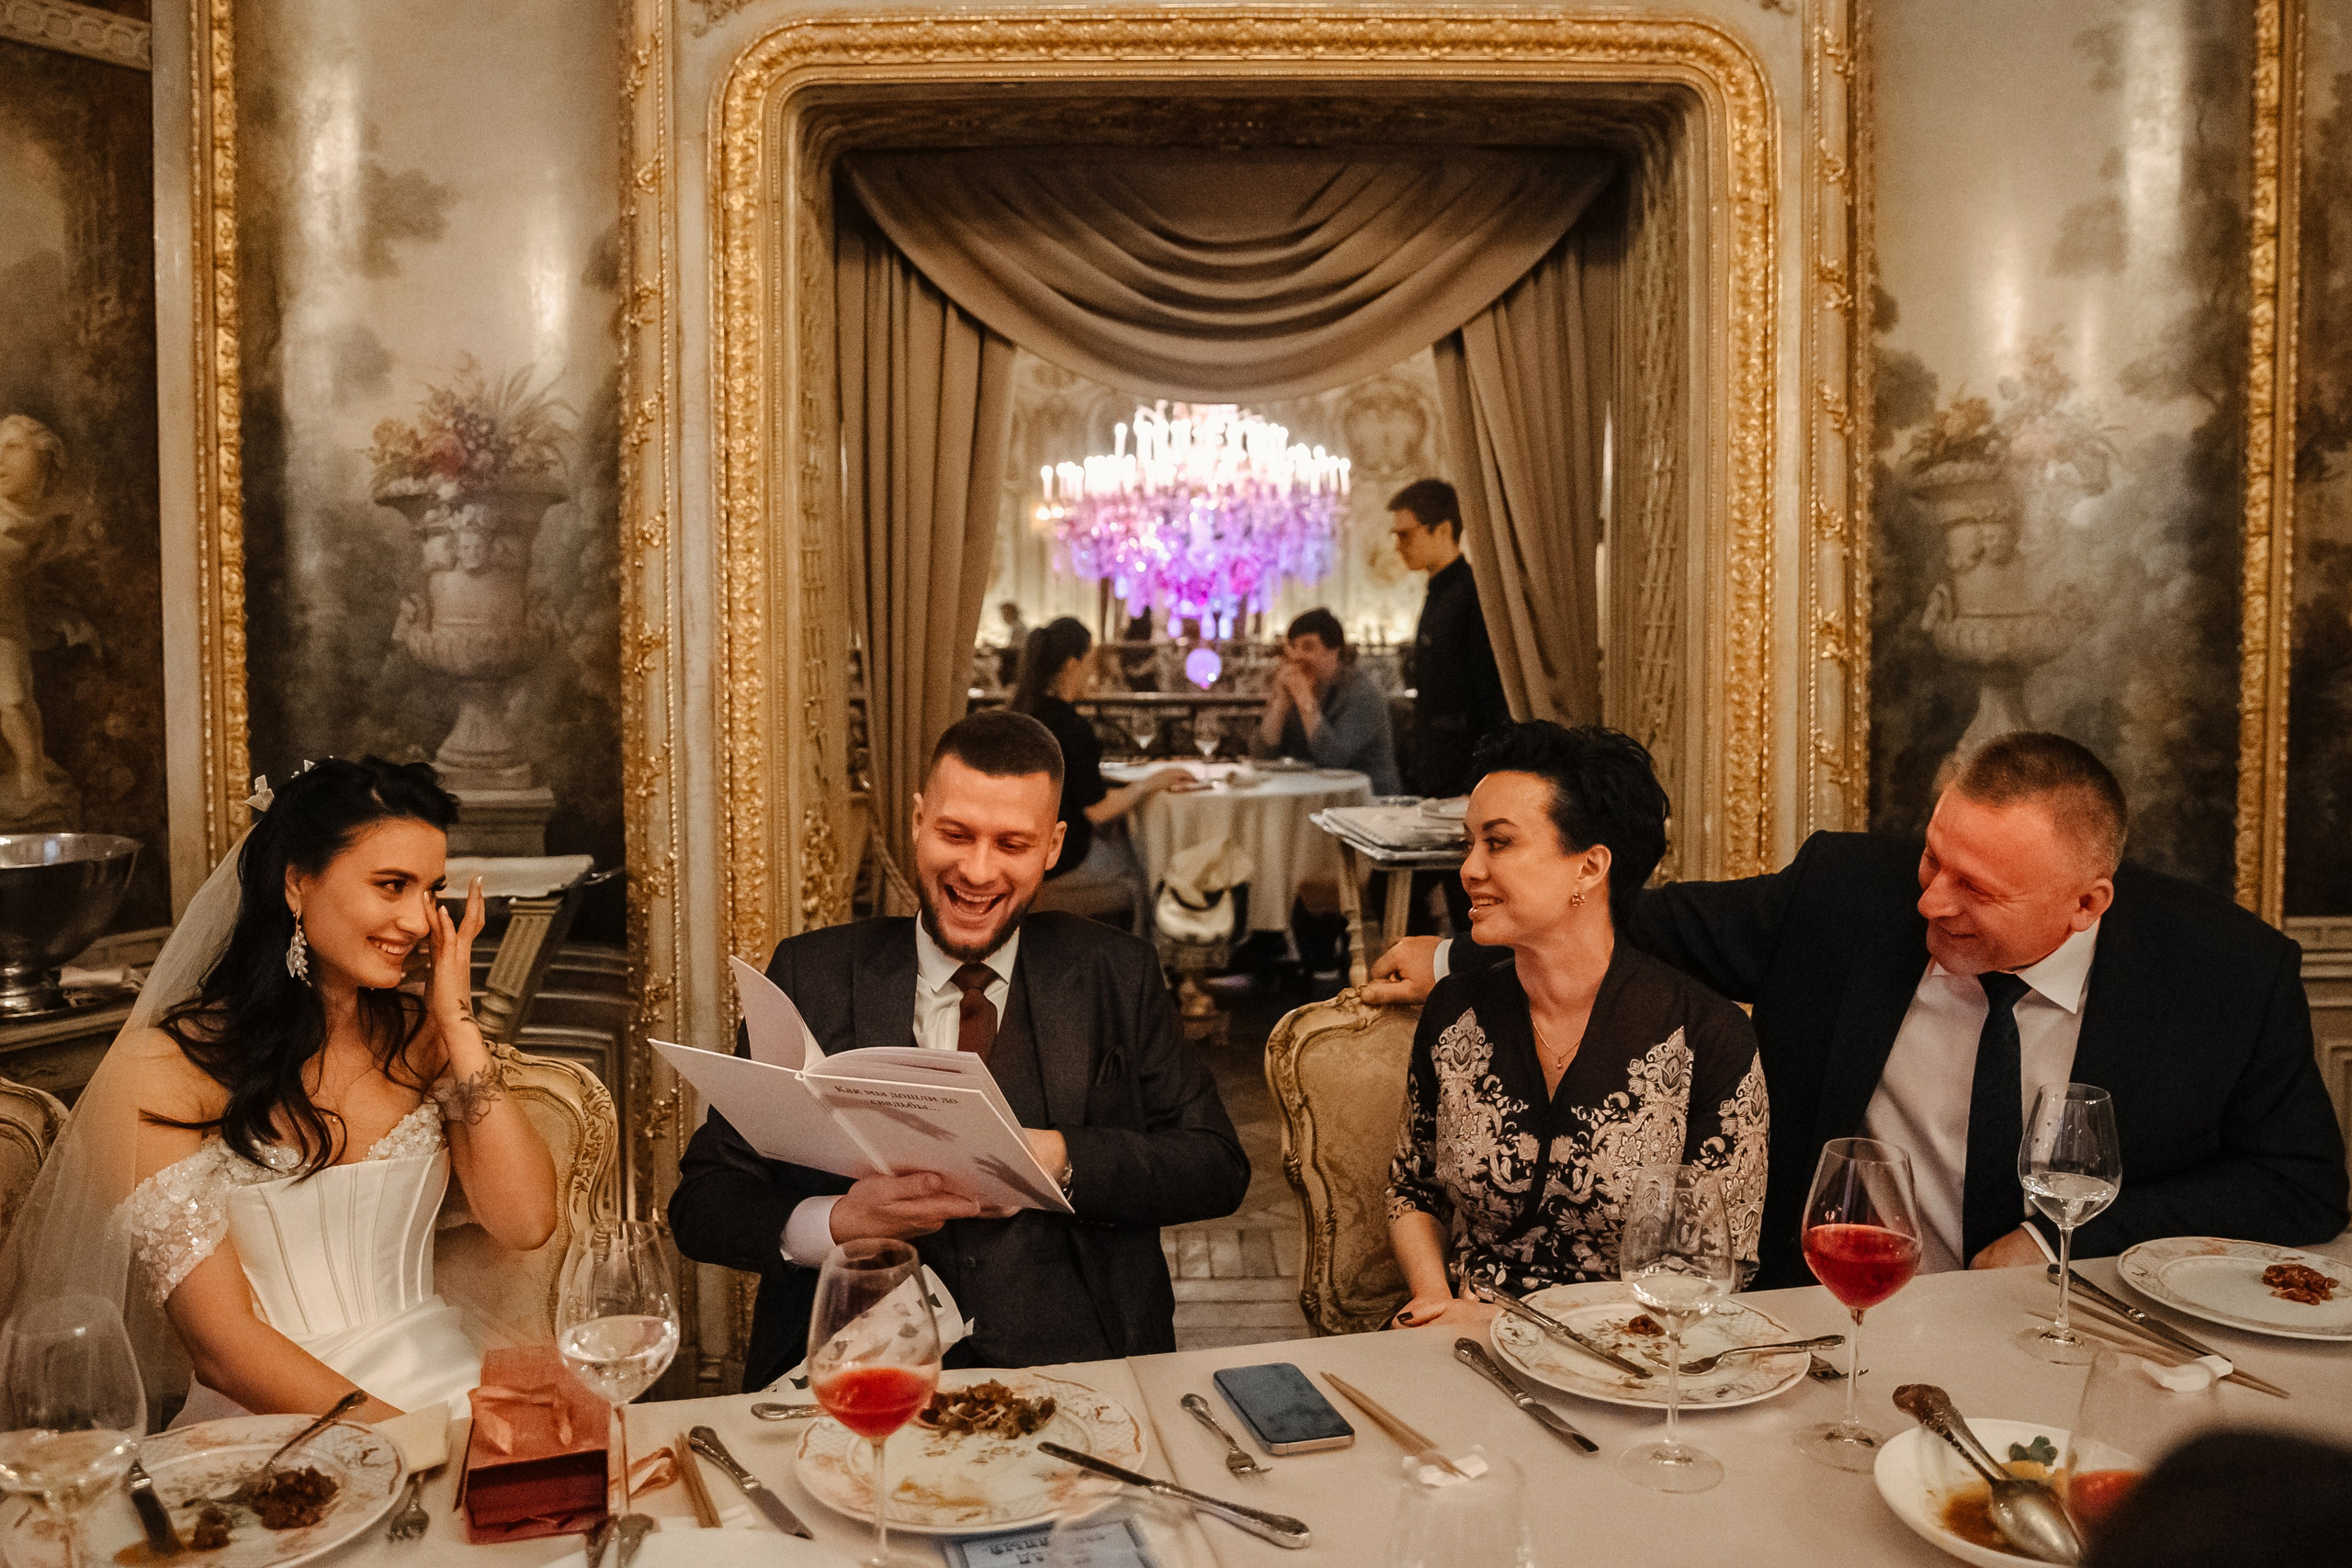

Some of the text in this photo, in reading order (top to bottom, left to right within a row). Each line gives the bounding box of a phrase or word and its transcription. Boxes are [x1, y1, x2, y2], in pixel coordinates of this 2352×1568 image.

[834, 1085, 958, 1105] Как мы дошли до
[870, 1100, 941, 1111] свадьбы...
